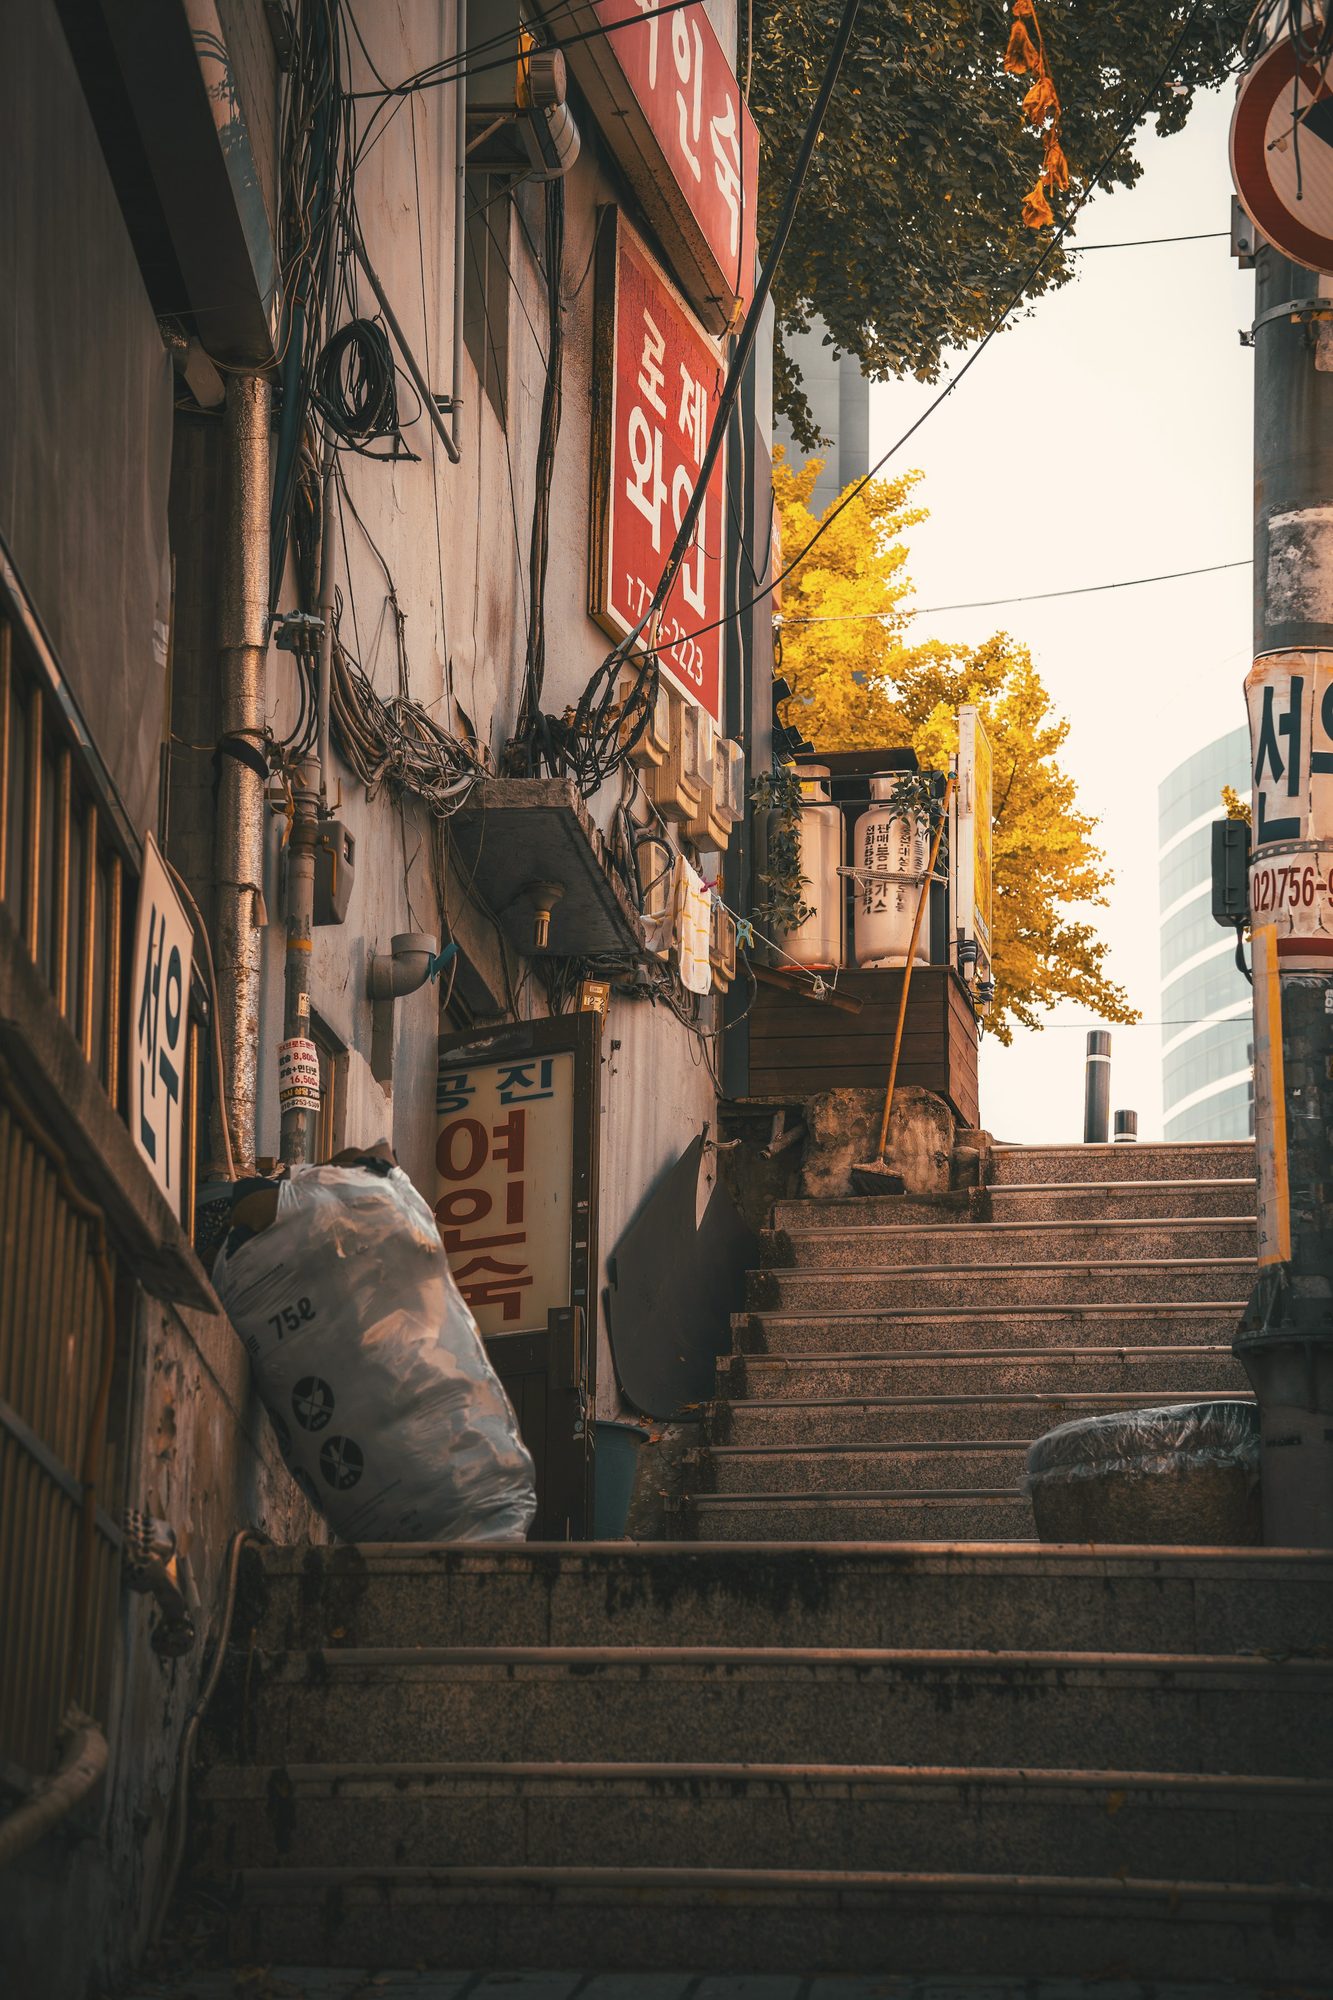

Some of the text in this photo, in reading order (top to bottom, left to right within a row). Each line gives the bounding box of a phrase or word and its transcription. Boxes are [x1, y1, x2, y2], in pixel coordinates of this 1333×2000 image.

[638, 307, 707, 471] 로제
[626, 405, 707, 622] 와인
[435, 1109, 533, 1321] 여인숙
